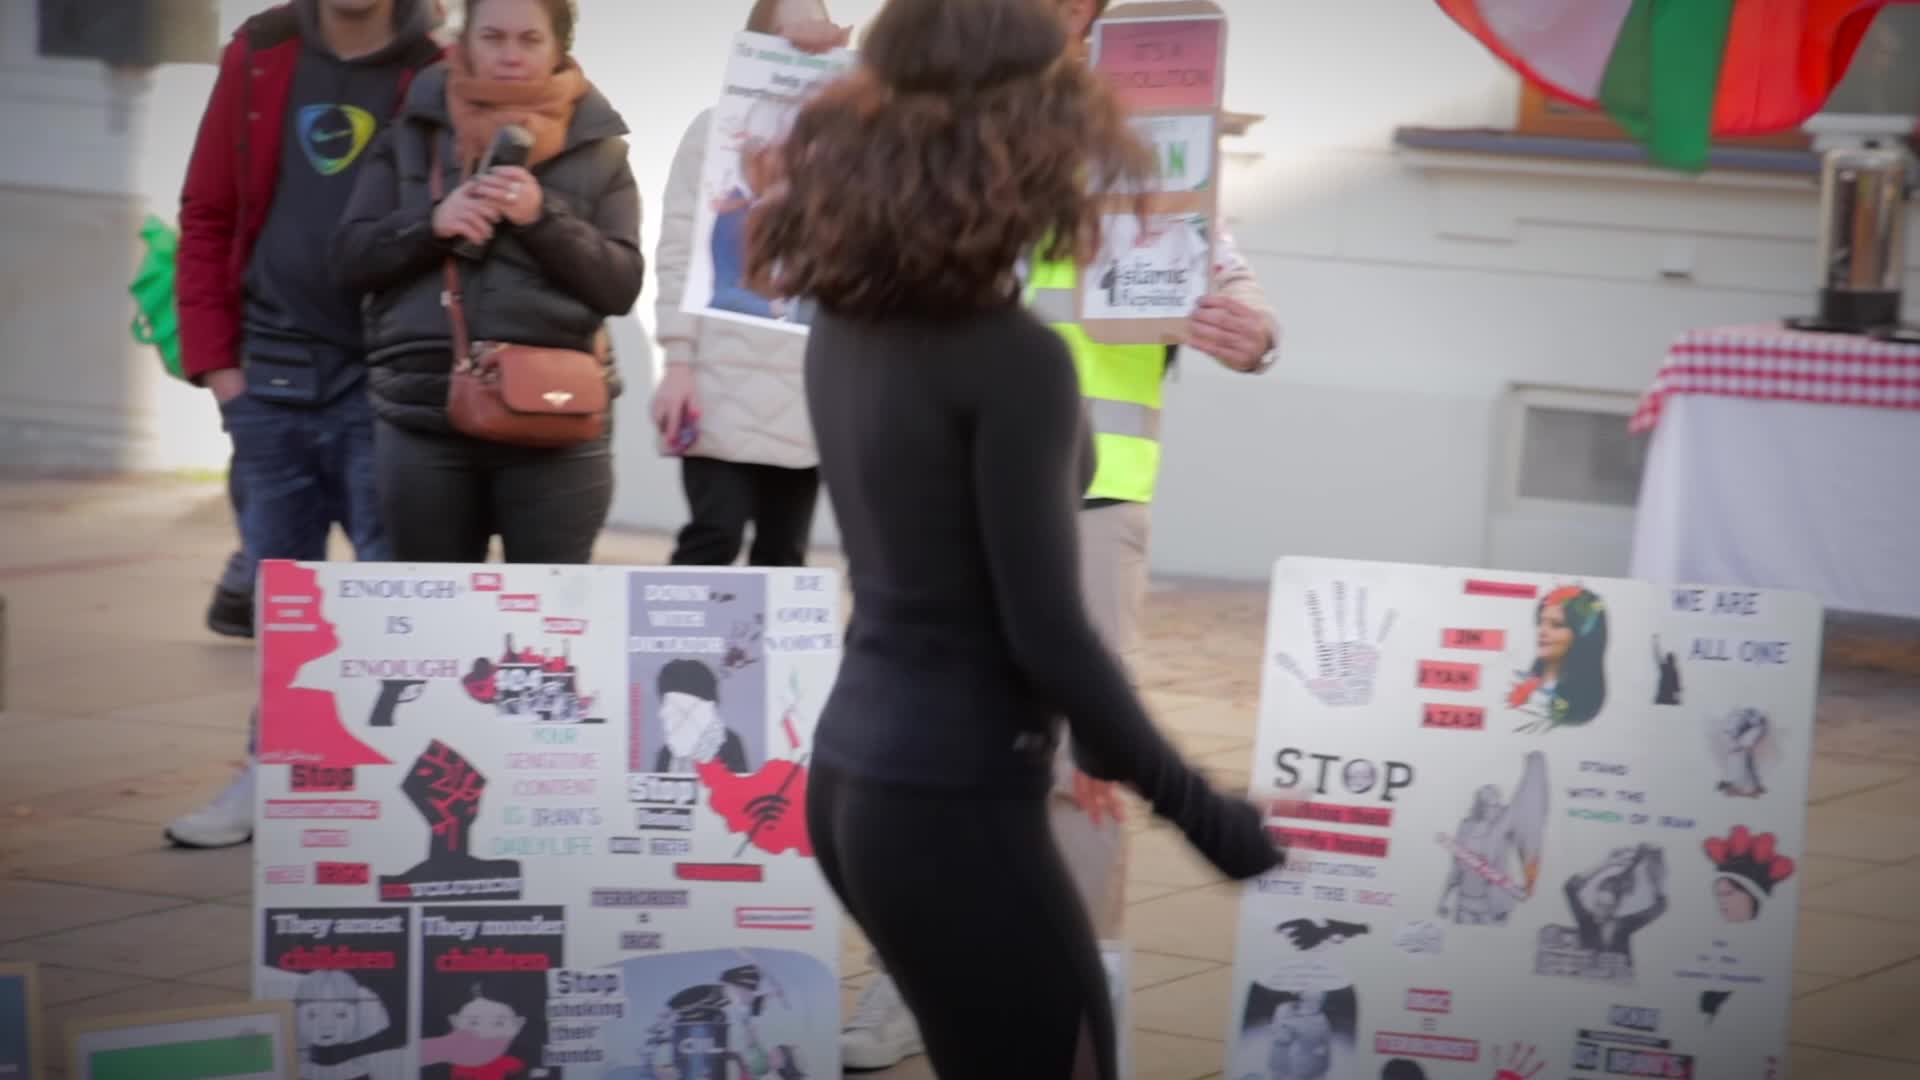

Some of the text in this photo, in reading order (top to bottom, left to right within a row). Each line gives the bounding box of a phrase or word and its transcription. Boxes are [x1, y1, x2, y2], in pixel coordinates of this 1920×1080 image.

[338, 578, 457, 599] ENOUGH
[1672, 589, 1761, 615] WE ARE
[385, 615, 414, 635] IS
[1688, 638, 1792, 664] ALL ONE
[339, 659, 459, 678] ENOUGH
[290, 764, 355, 790] Stop
[1273, 747, 1415, 802] STOP
[271, 913, 404, 939] They arrest
[421, 914, 565, 941] They murder
[279, 945, 396, 970] children
[435, 946, 552, 972] children
[556, 970, 621, 996] Stop
